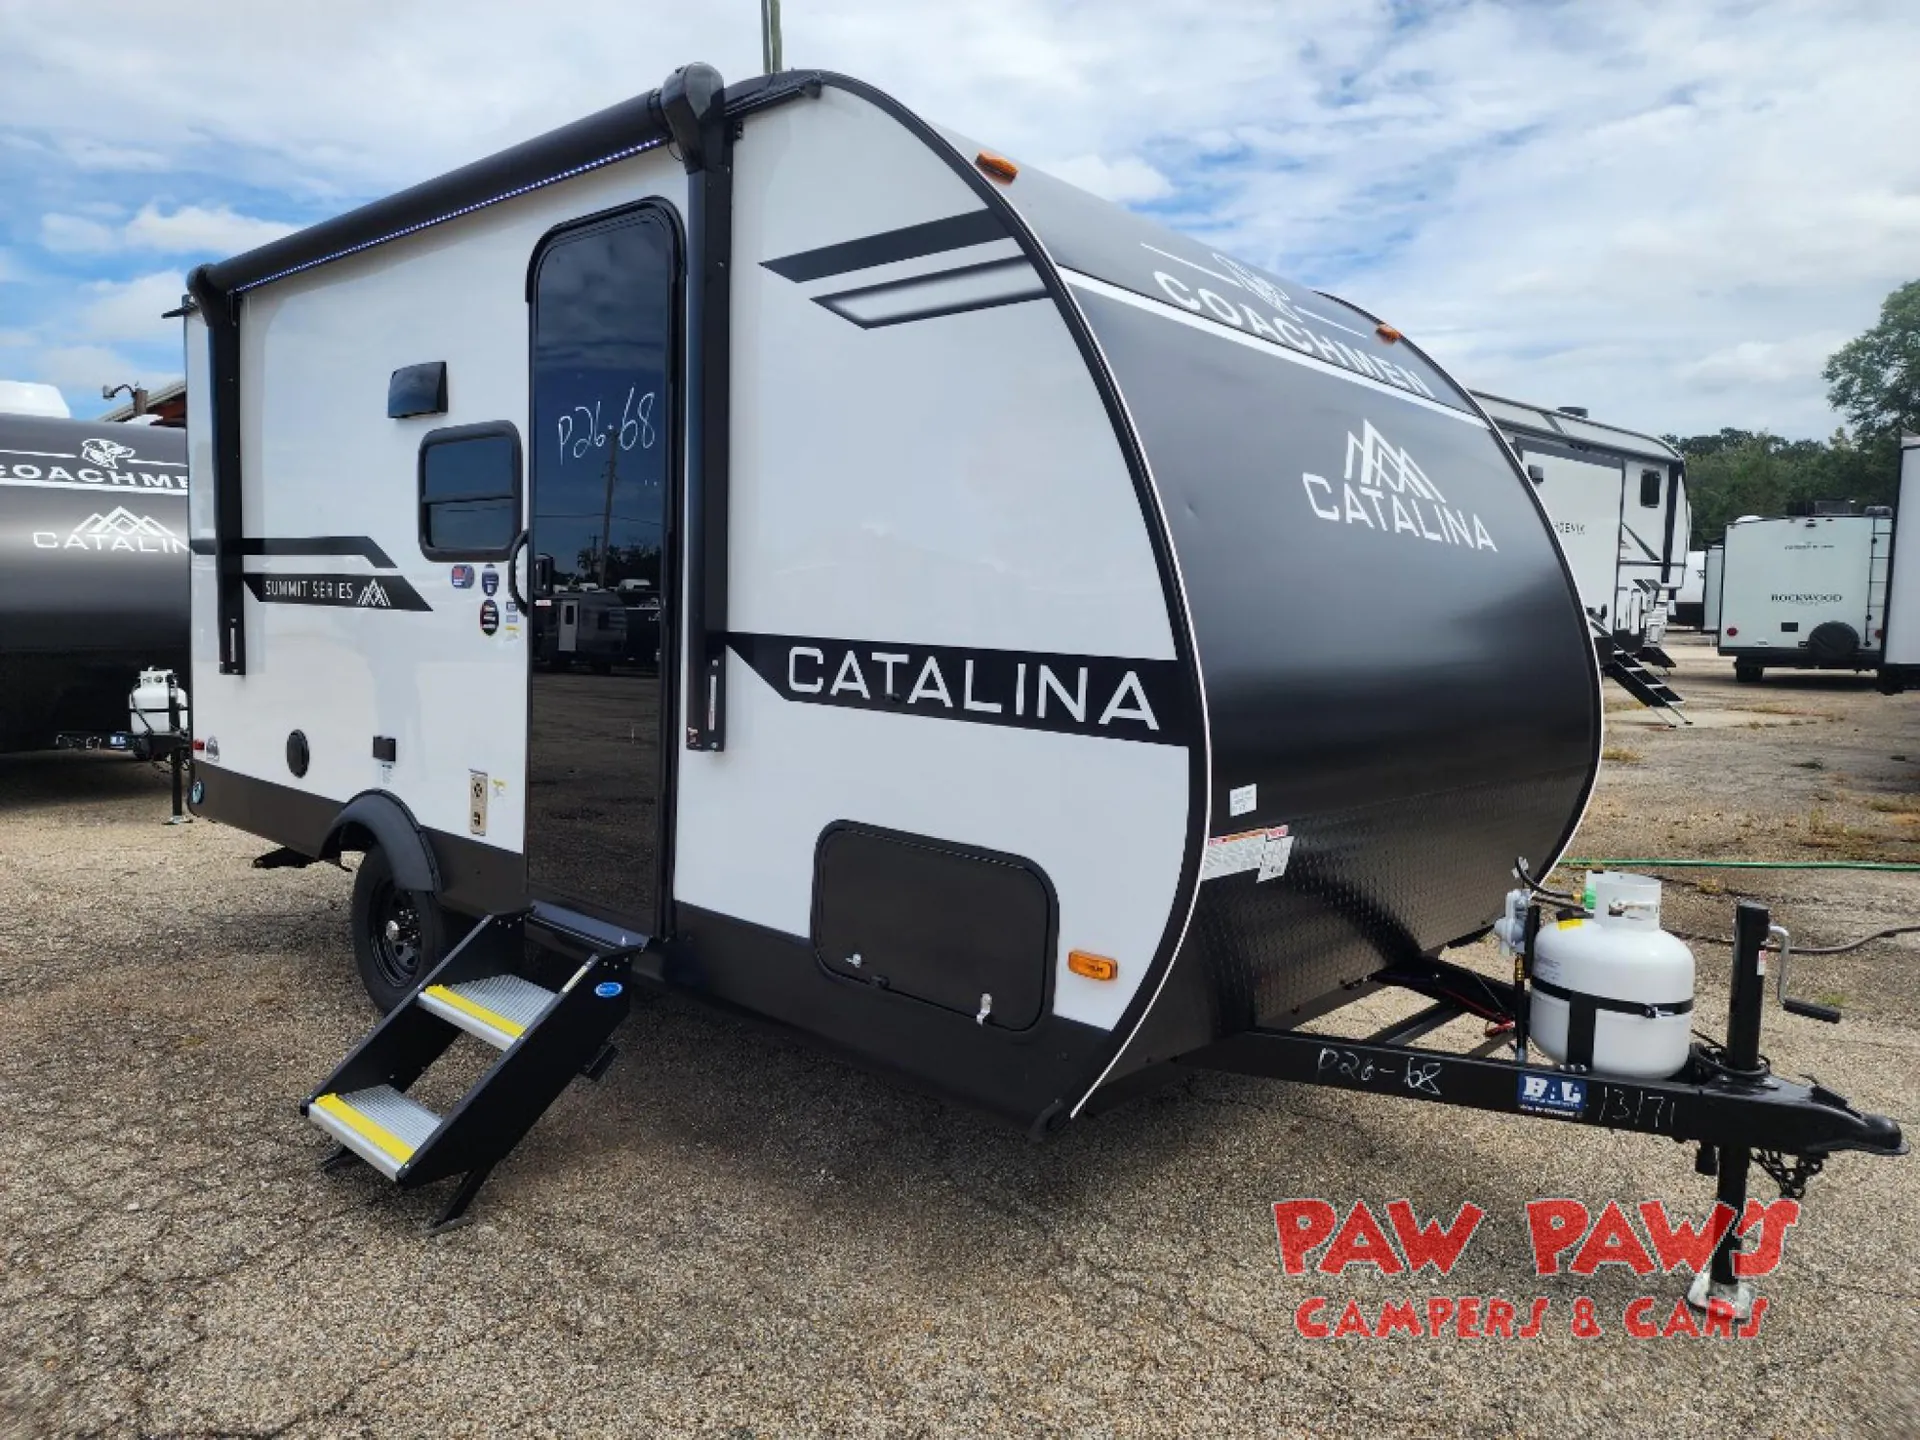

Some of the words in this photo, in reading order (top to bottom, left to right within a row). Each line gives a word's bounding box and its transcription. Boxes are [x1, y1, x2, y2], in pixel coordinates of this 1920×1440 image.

[1153, 271, 1435, 399] COACHMEN
[0, 463, 188, 489] OACHME
[1302, 472, 1498, 552] CATALINA
[265, 580, 308, 597] SUMMIT
[312, 582, 353, 599] SERIES
[1771, 594, 1842, 602] ROCKWOOD
[788, 646, 1160, 731] CATALINA
